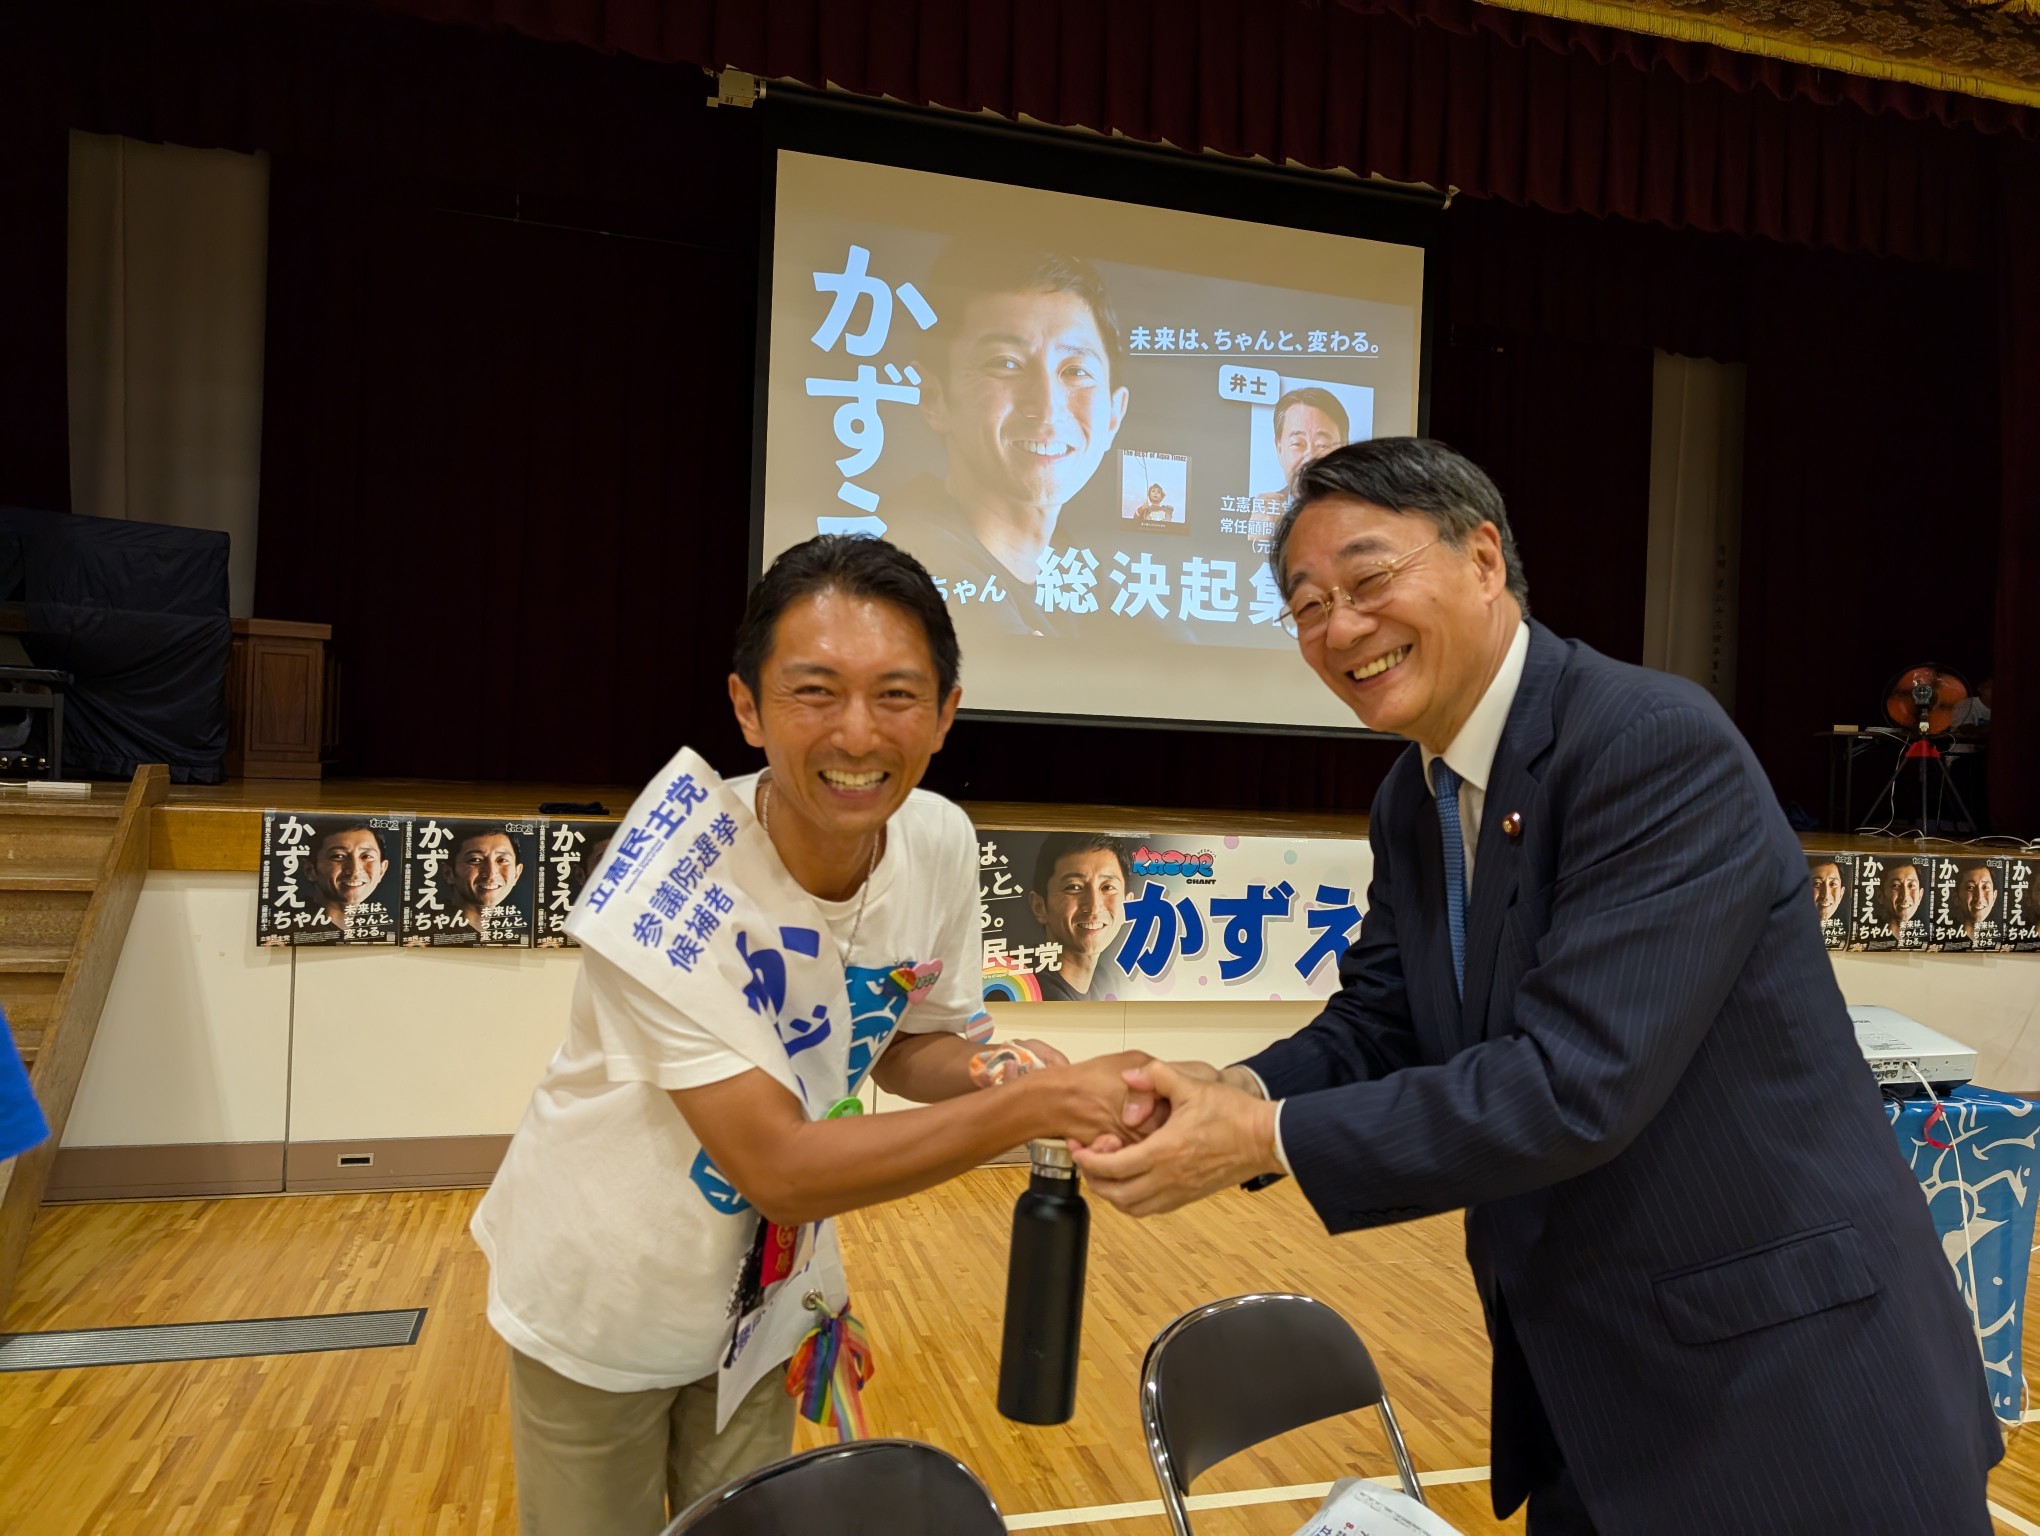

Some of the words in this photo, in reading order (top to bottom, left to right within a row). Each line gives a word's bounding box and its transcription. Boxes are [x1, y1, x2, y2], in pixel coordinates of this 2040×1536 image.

[1129, 326, 1379, 354] 未来は、ちゃんと、変わる。
[1229, 372, 1268, 396] 弁士
[1220, 518, 1276, 537] 常任顧問
[585, 773, 710, 915] 立憲民主党
[274, 816, 316, 908] かずえ
[415, 820, 455, 910] かずえ
[549, 823, 586, 912] かずえ
[632, 812, 740, 949] 参議院選挙
[1185, 878, 1217, 886] CHANT
[1860, 856, 1884, 924] かずえ
[1936, 858, 1960, 926] かずえ
[2009, 860, 2033, 926] かずえ
[273, 907, 333, 930] ちゃん
[344, 902, 388, 915] 未来は、
[481, 905, 522, 917] 未来は、
[344, 914, 394, 927] ちゃんと、
[414, 909, 470, 931] ちゃん
[480, 916, 528, 929] ちゃんと、
[665, 884, 735, 974] 候補者
[344, 926, 386, 940] 変わる。
[480, 929, 520, 941] 変わる。
[1822, 927, 1847, 936] ゃんと、
[1859, 923, 1893, 940] ちゃん
[1935, 924, 1968, 941] ちゃん
[2008, 925, 2040, 941] ちゃん
